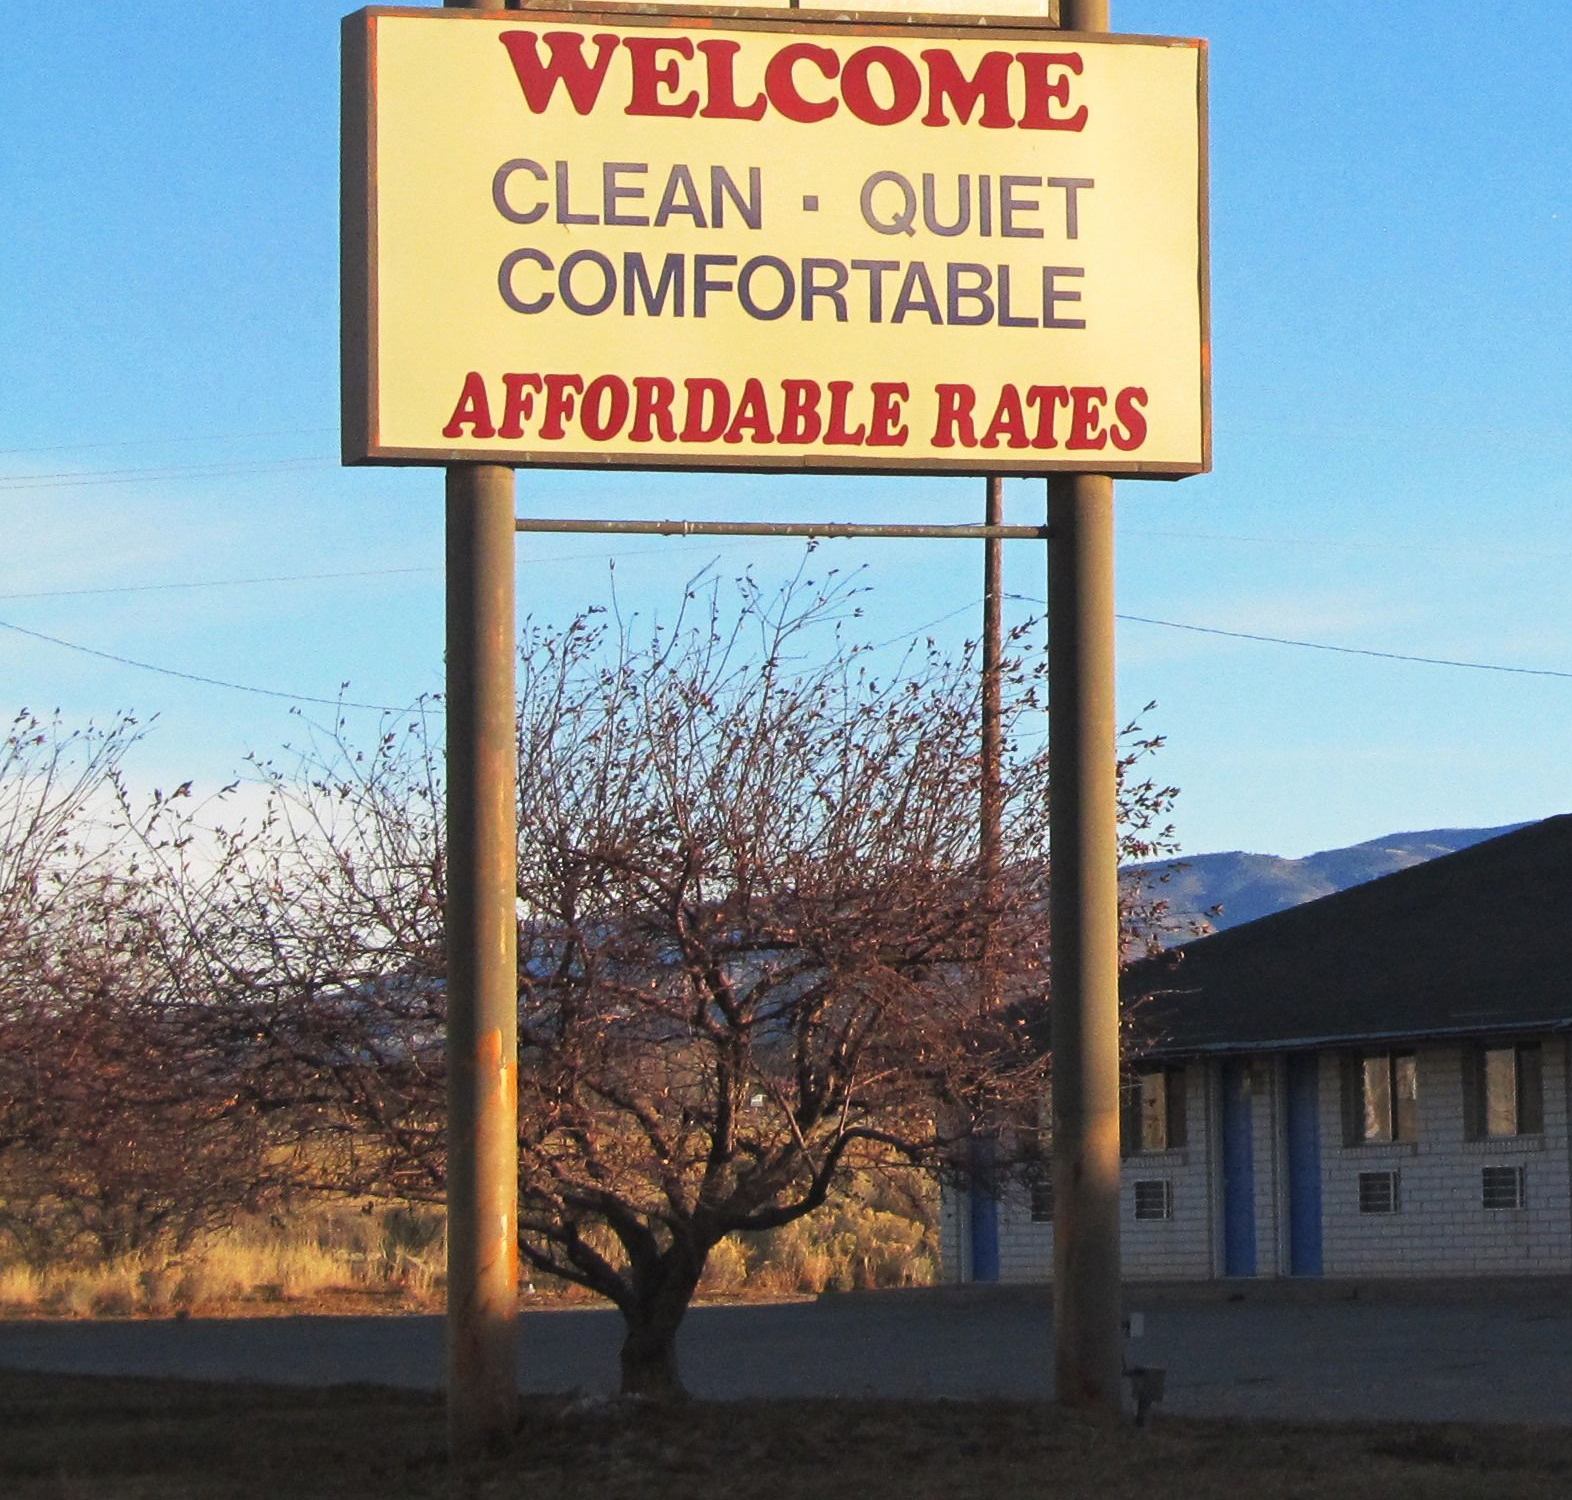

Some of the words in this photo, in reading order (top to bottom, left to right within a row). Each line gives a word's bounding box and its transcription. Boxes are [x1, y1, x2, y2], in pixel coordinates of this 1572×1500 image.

[499, 30, 1089, 133] WELCOME
[491, 158, 762, 230] CLEAN
[859, 171, 1095, 240] QUIET
[497, 247, 1087, 330] COMFORTABLE
[442, 371, 910, 448] AFFORDABLE
[931, 383, 1149, 453] RATES
